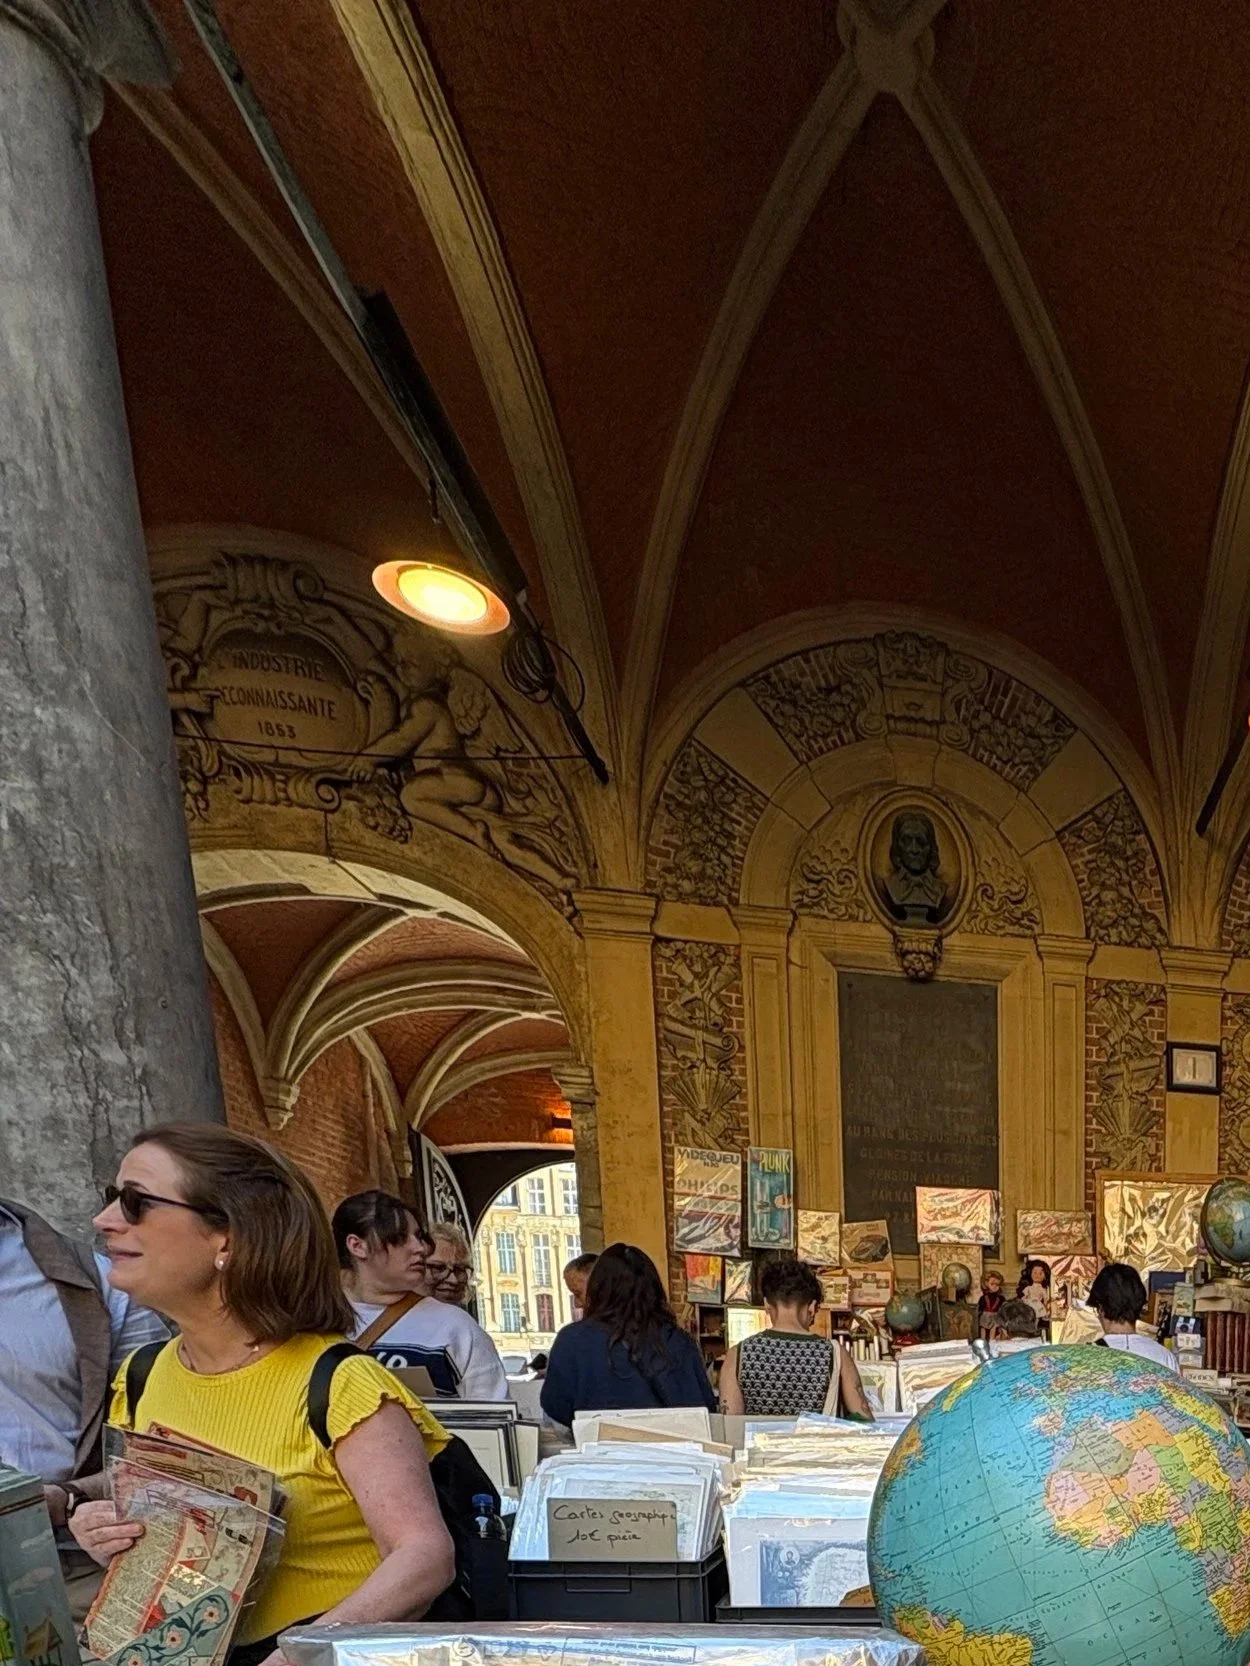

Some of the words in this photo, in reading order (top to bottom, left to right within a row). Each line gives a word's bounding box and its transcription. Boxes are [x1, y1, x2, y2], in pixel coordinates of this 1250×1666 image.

[257, 720, 297, 739] 1853
[759, 1151, 790, 1173] PLUNK
[553, 1504, 604, 1520] Cartes
